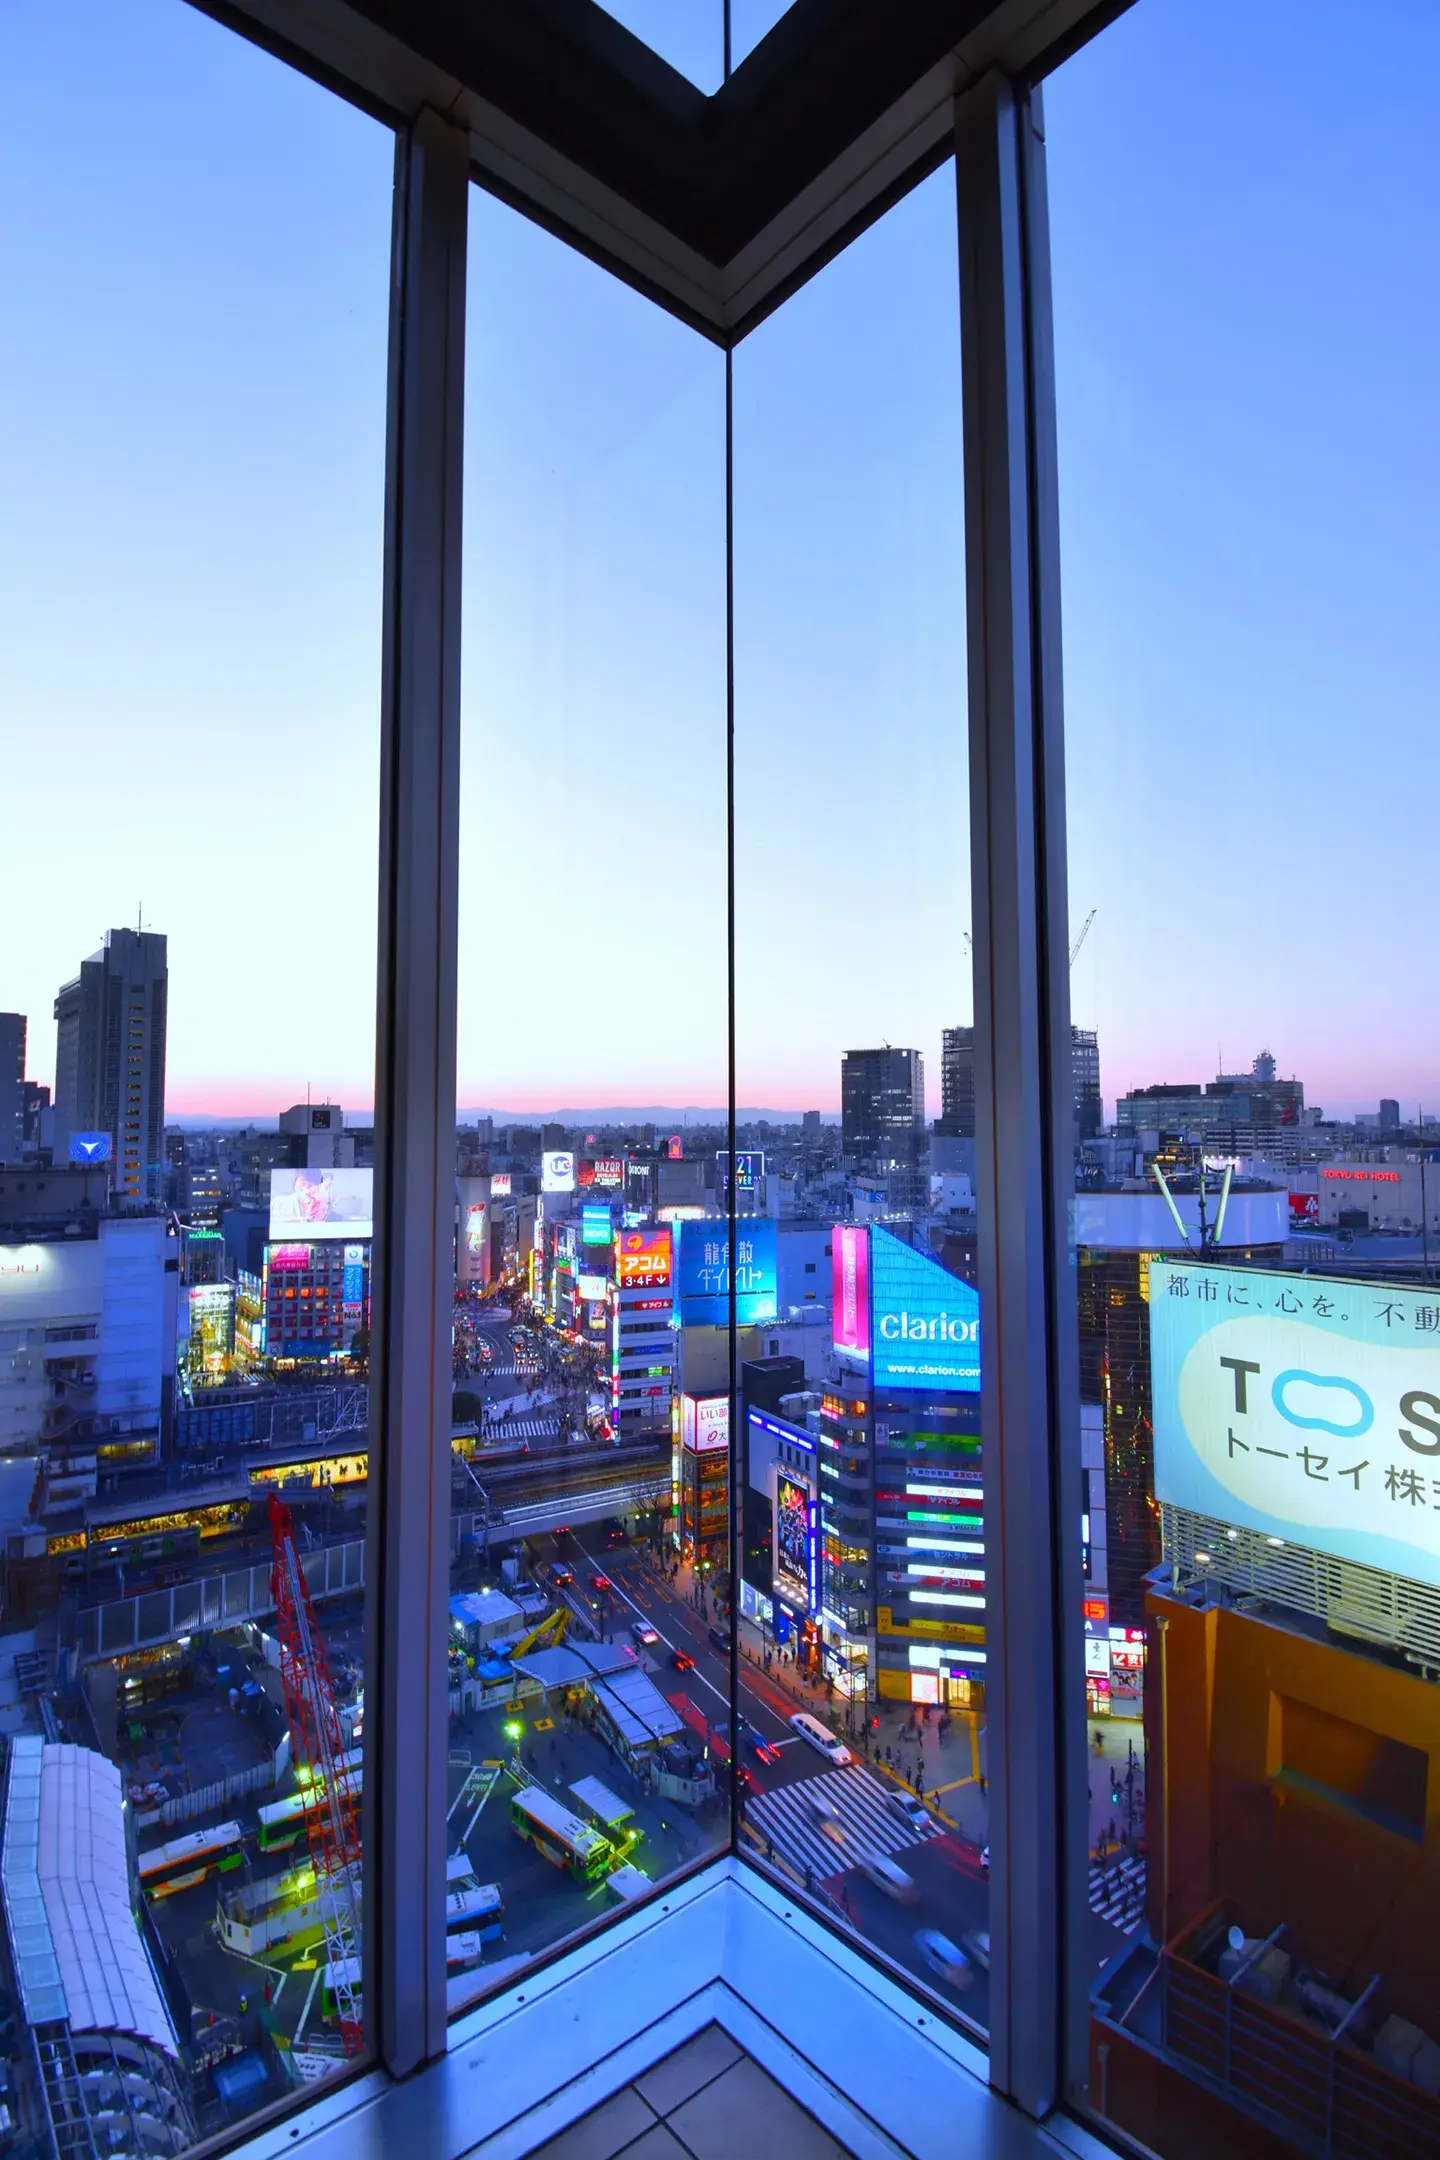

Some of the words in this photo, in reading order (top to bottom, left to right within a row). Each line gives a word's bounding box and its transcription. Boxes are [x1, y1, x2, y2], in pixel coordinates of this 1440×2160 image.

[594, 1161, 621, 1173] RAZOR
[736, 1156, 752, 1174] 21
[1323, 1169, 1352, 1179] TOKYU
[1354, 1171, 1368, 1180] REI
[1370, 1172, 1400, 1182] HOTEL
[625, 1255, 667, 1272] アコム
[887, 1363, 981, 1377] www.clarion.com
[1228, 1427, 1440, 1512] トーセイ株
[933, 1550, 969, 1560] セントラル
[941, 1577, 971, 1588] アコム
